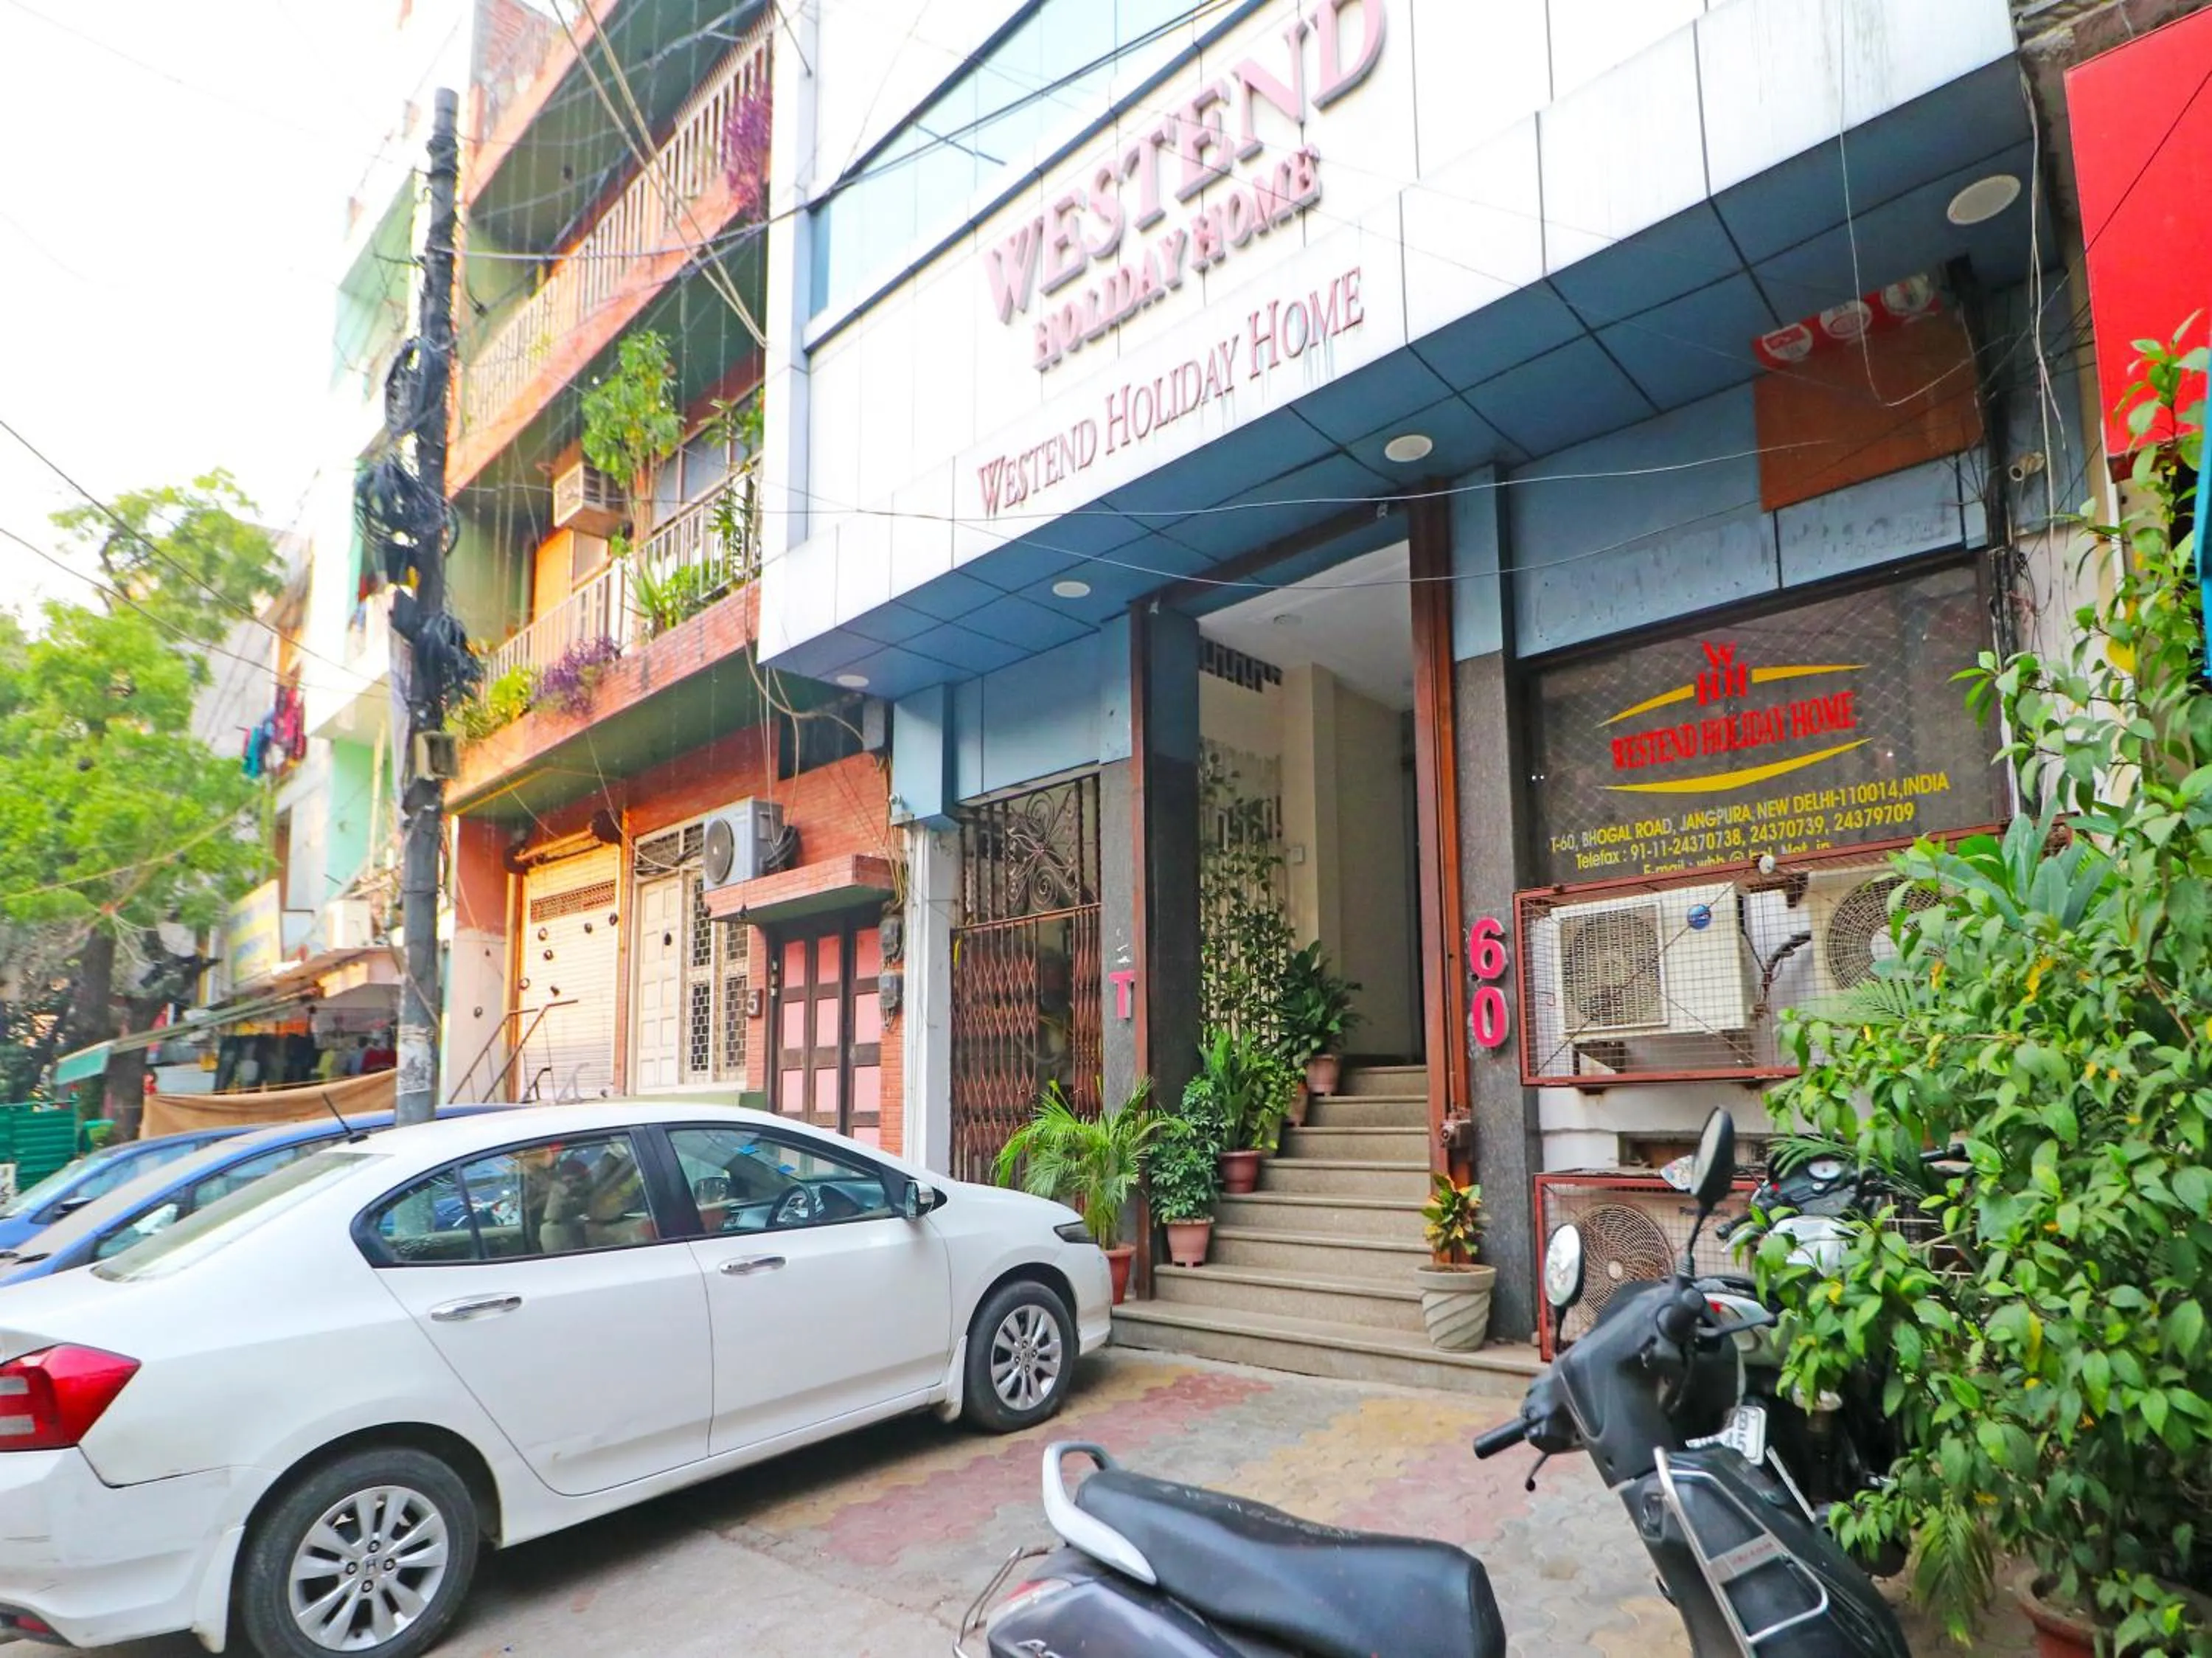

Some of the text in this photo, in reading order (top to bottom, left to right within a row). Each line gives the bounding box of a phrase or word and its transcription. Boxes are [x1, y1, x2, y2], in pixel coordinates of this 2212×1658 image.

[982, 0, 1386, 325] WESTEND
[1033, 143, 1322, 372] HOLIDAY HOME
[1610, 690, 1856, 771] WESTEND HOLIDAY HOME
[1576, 851, 1621, 870] Telefax
[1630, 831, 1746, 861] 91-11-24370738,
[1750, 816, 1829, 843] 24370739,
[1834, 802, 1914, 831] 24379709
[1582, 825, 1632, 847] BHOGAL
[1635, 818, 1676, 839] ROAD,
[1757, 798, 1789, 819] NEW
[1109, 968, 1135, 1019] T
